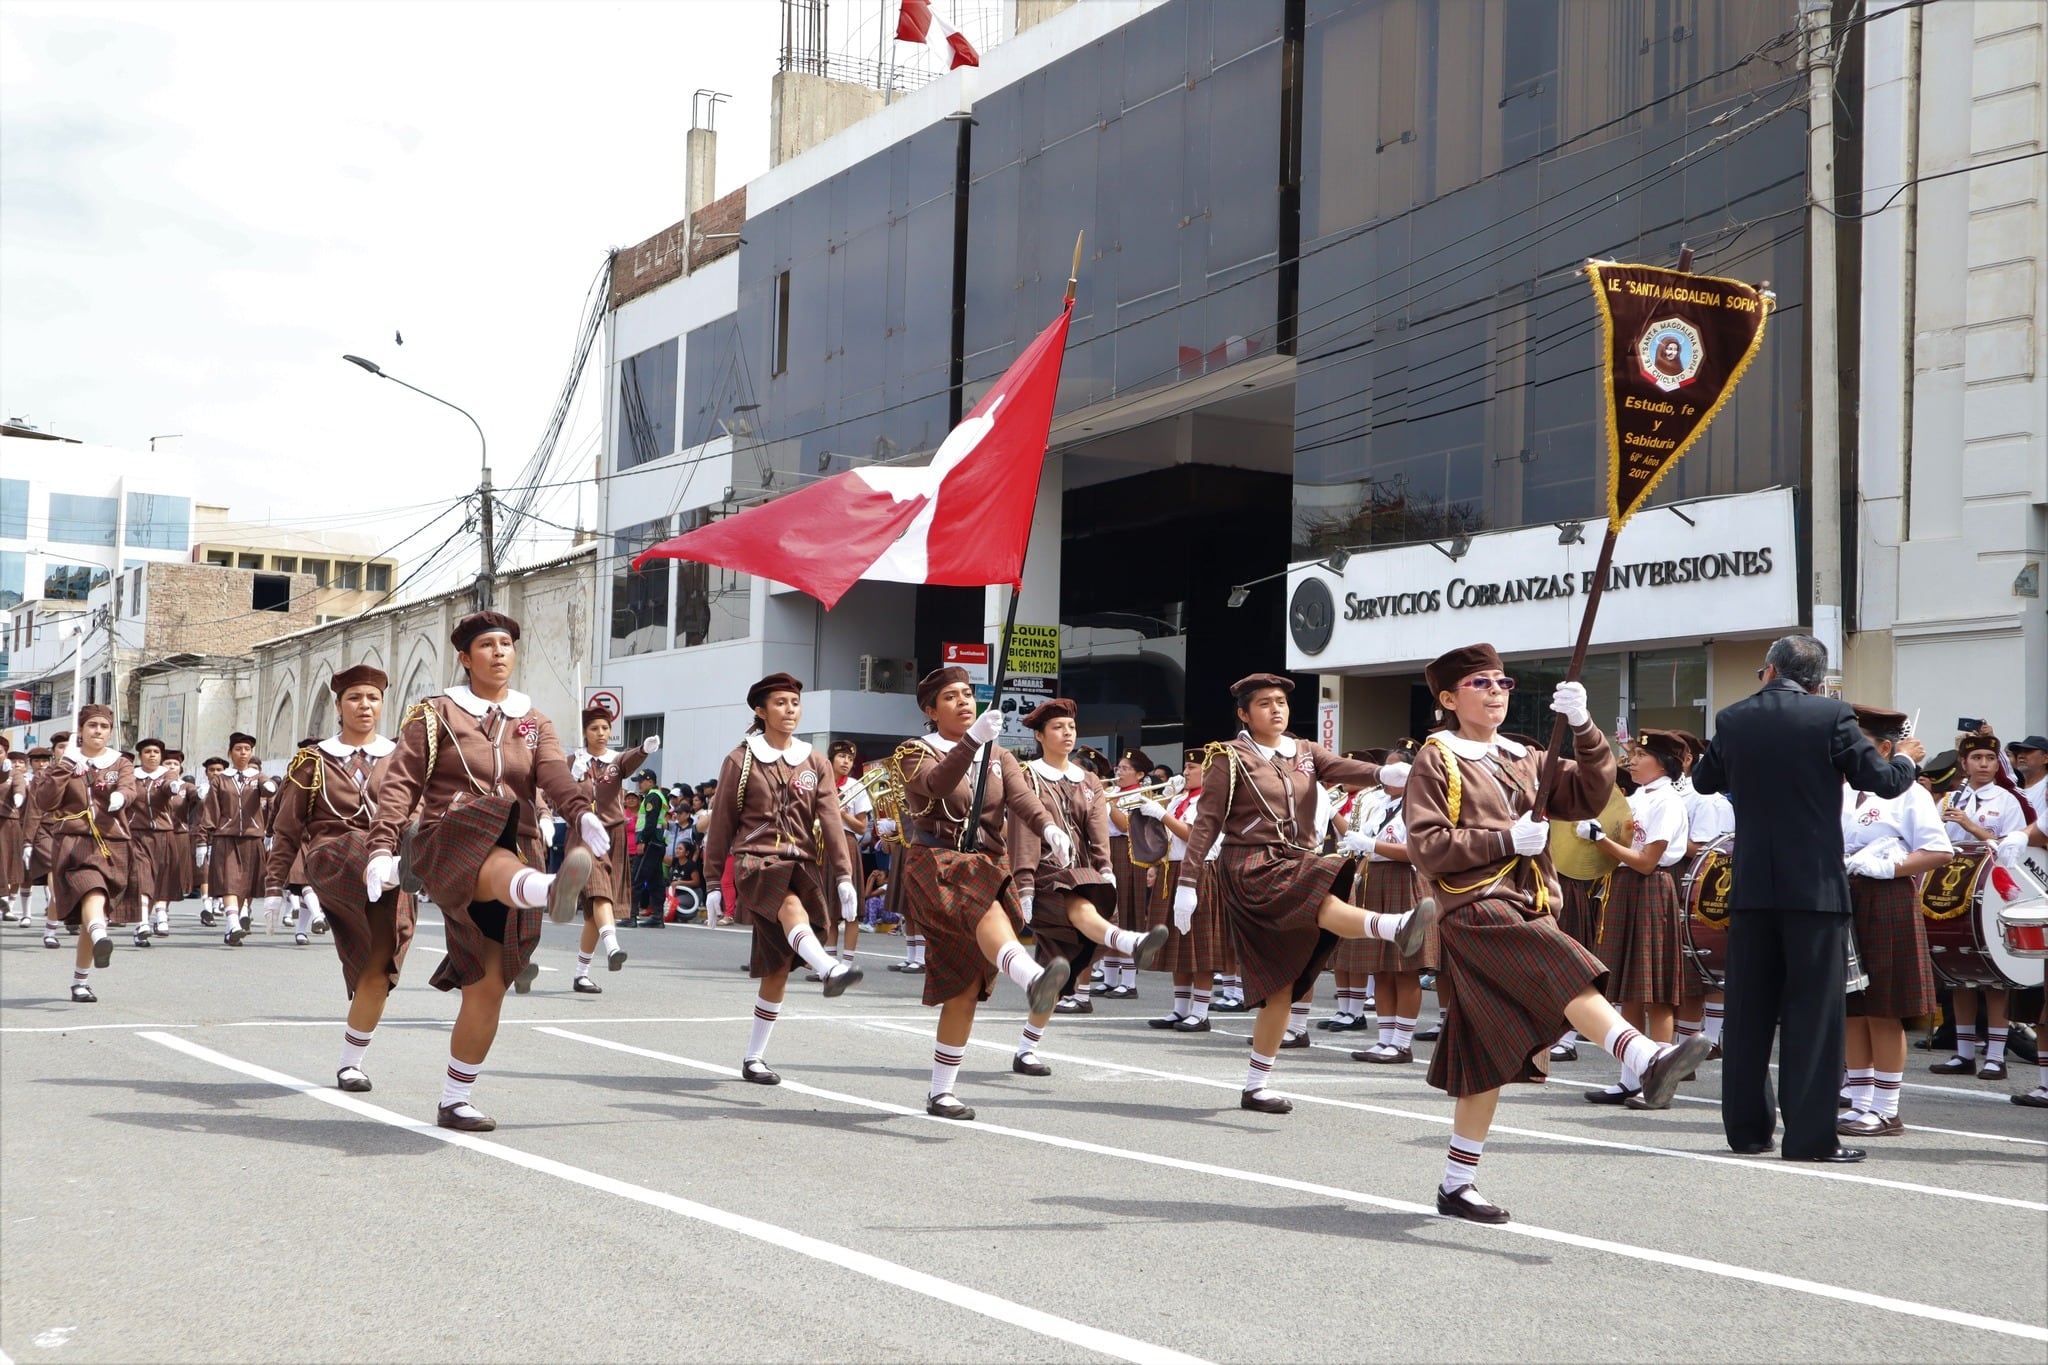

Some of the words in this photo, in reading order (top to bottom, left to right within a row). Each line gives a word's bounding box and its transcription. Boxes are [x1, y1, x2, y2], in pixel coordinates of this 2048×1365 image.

[1662, 286, 1721, 307] MAGDALENA
[1660, 322, 1697, 347] MAGDALENA
[1652, 370, 1685, 384] CHICLAYO
[1625, 396, 1675, 416] Estudio,
[1681, 404, 1695, 415] fe
[1652, 419, 1663, 431] y
[1628, 468, 1650, 479] 2017
[1344, 590, 1440, 621] SERVICIOS
[1446, 572, 1575, 609] COBRANZAS
[1002, 626, 1057, 638] LQUILO
[1011, 637, 1055, 649] FICINAS
[1006, 659, 1016, 672] EL.
[1323, 710, 1333, 752] TOUR
